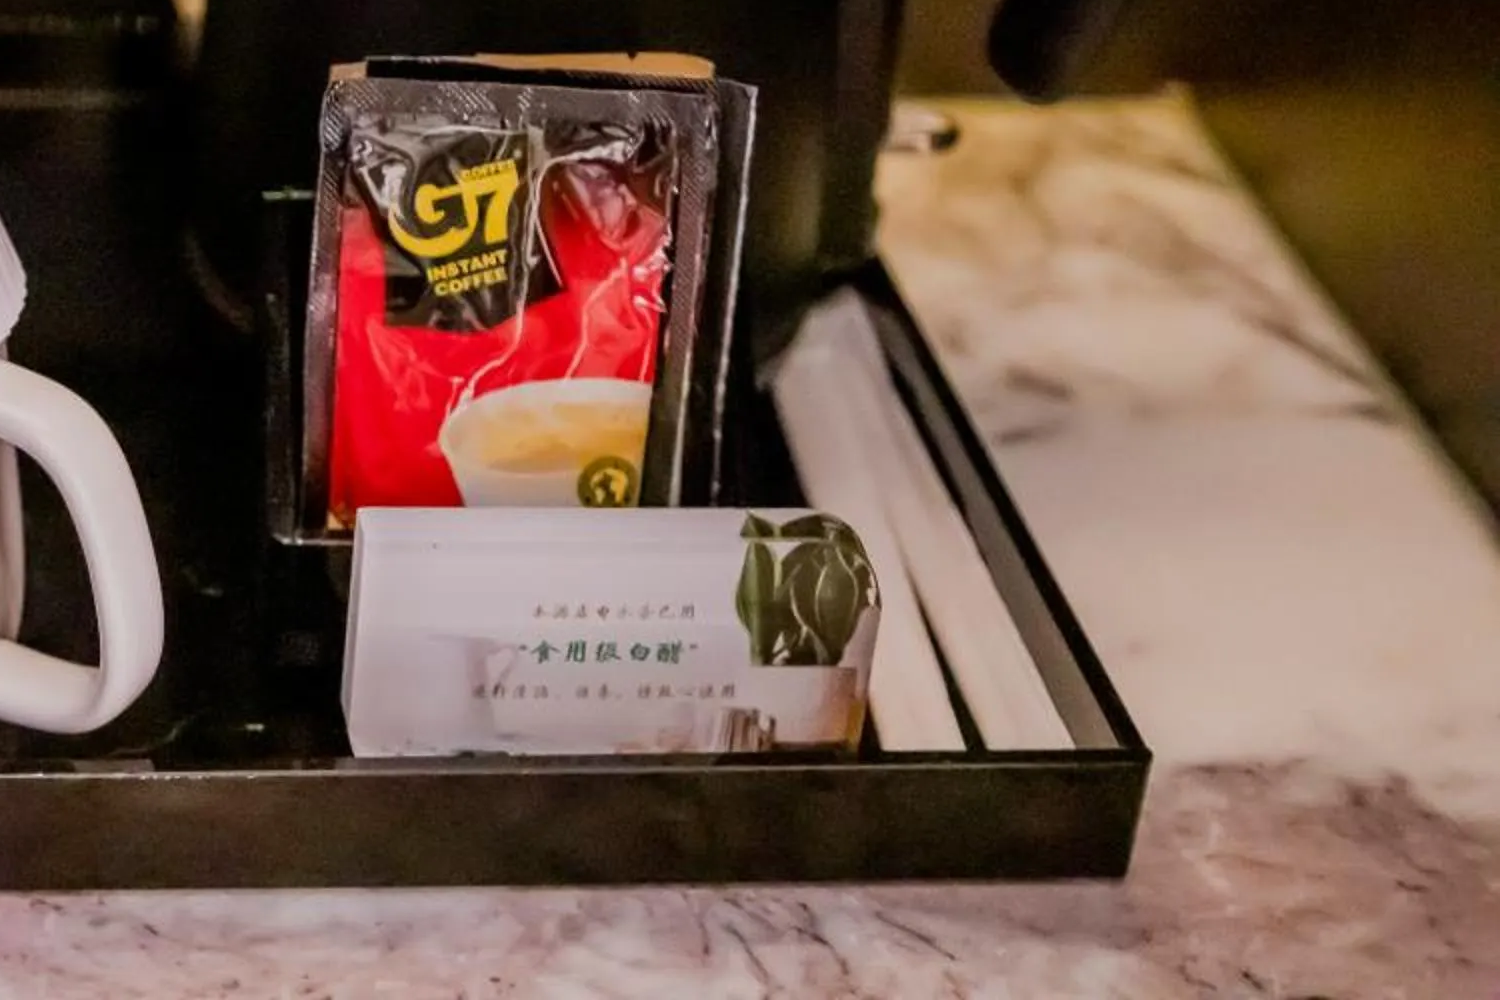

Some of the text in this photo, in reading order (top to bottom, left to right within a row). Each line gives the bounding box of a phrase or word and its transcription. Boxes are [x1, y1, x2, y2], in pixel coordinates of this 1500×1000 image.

[388, 164, 519, 258] G7
[426, 249, 508, 284] INSTANT
[434, 266, 508, 297] COFFEE
